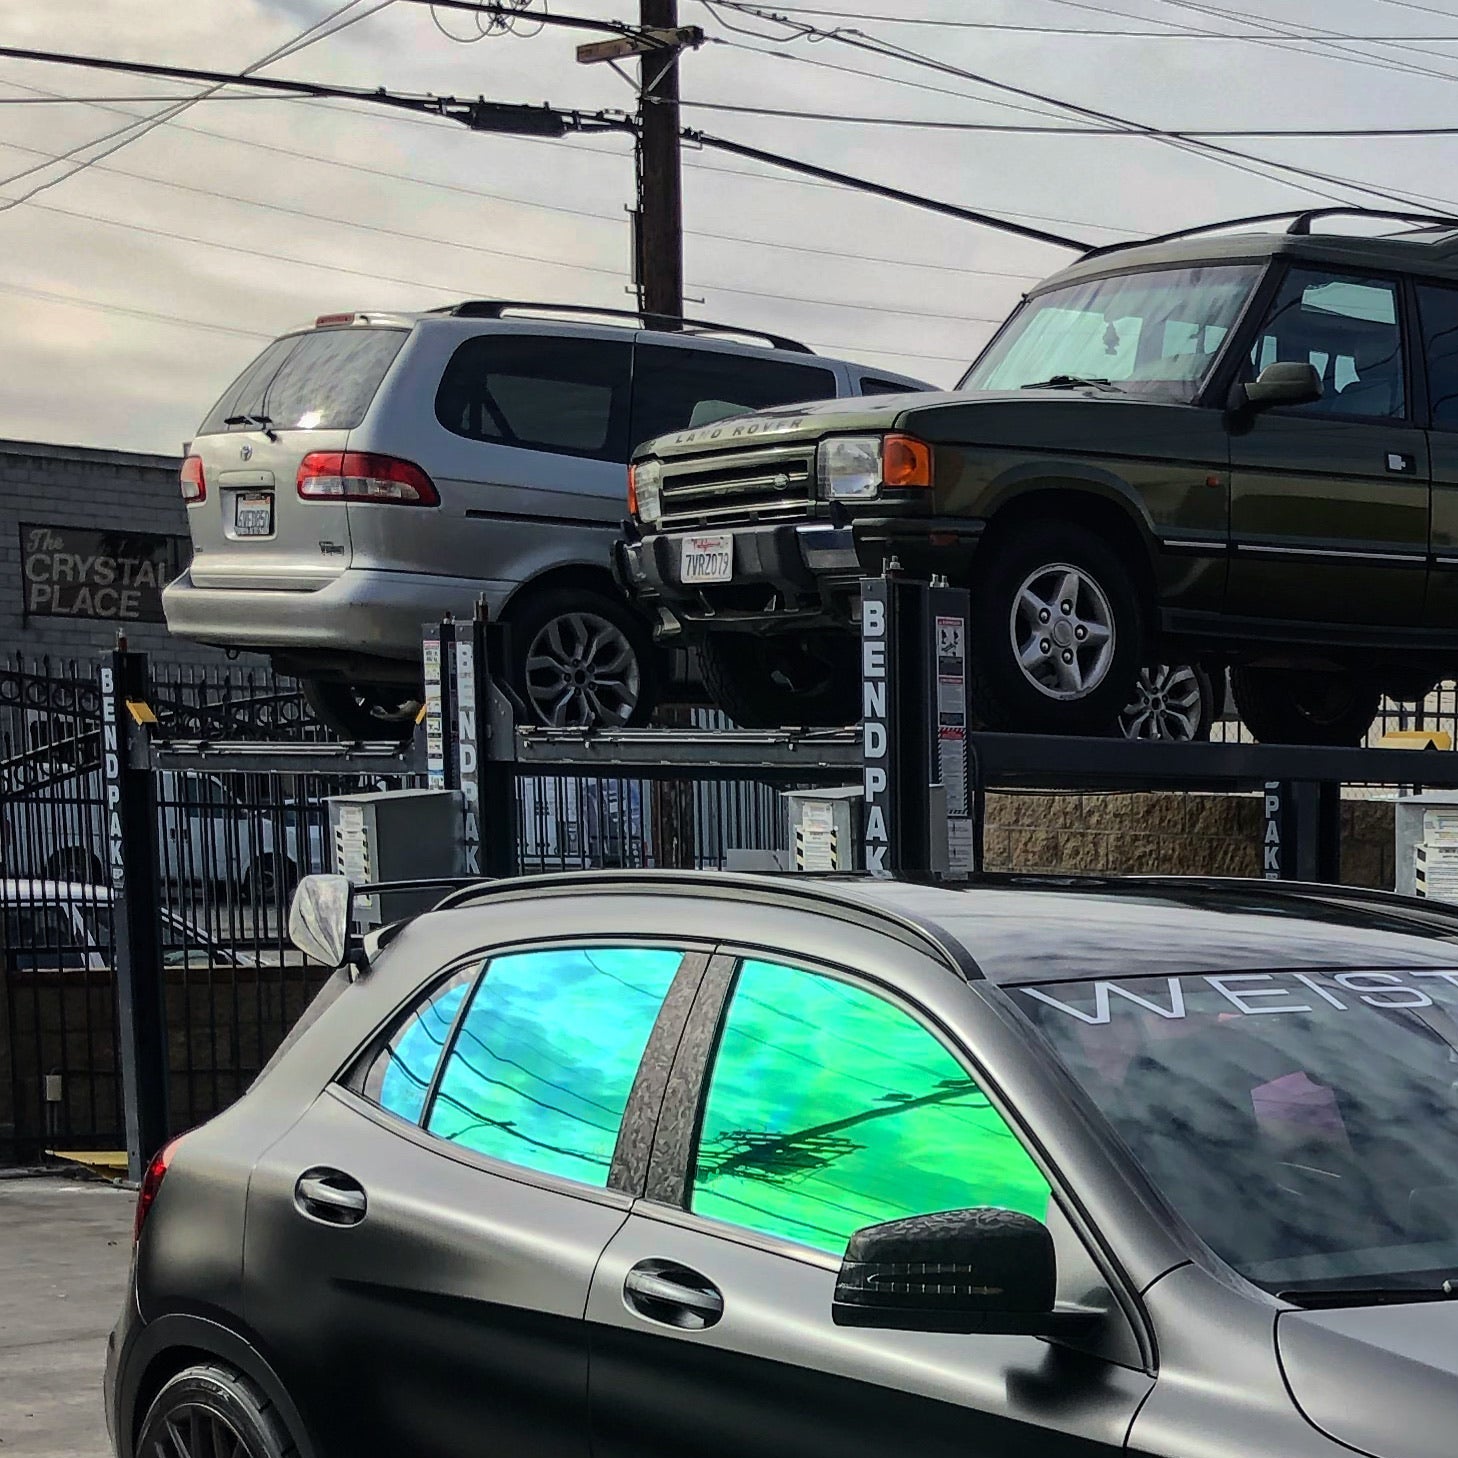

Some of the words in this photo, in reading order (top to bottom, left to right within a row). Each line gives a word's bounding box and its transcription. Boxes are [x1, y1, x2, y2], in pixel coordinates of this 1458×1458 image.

[732, 418, 804, 437] ROVER
[27, 528, 65, 551] The
[685, 552, 730, 576] 7VRZ079
[29, 583, 142, 618] PLACE
[862, 600, 888, 871] BENDPAK
[101, 667, 124, 866] BENDPAK
